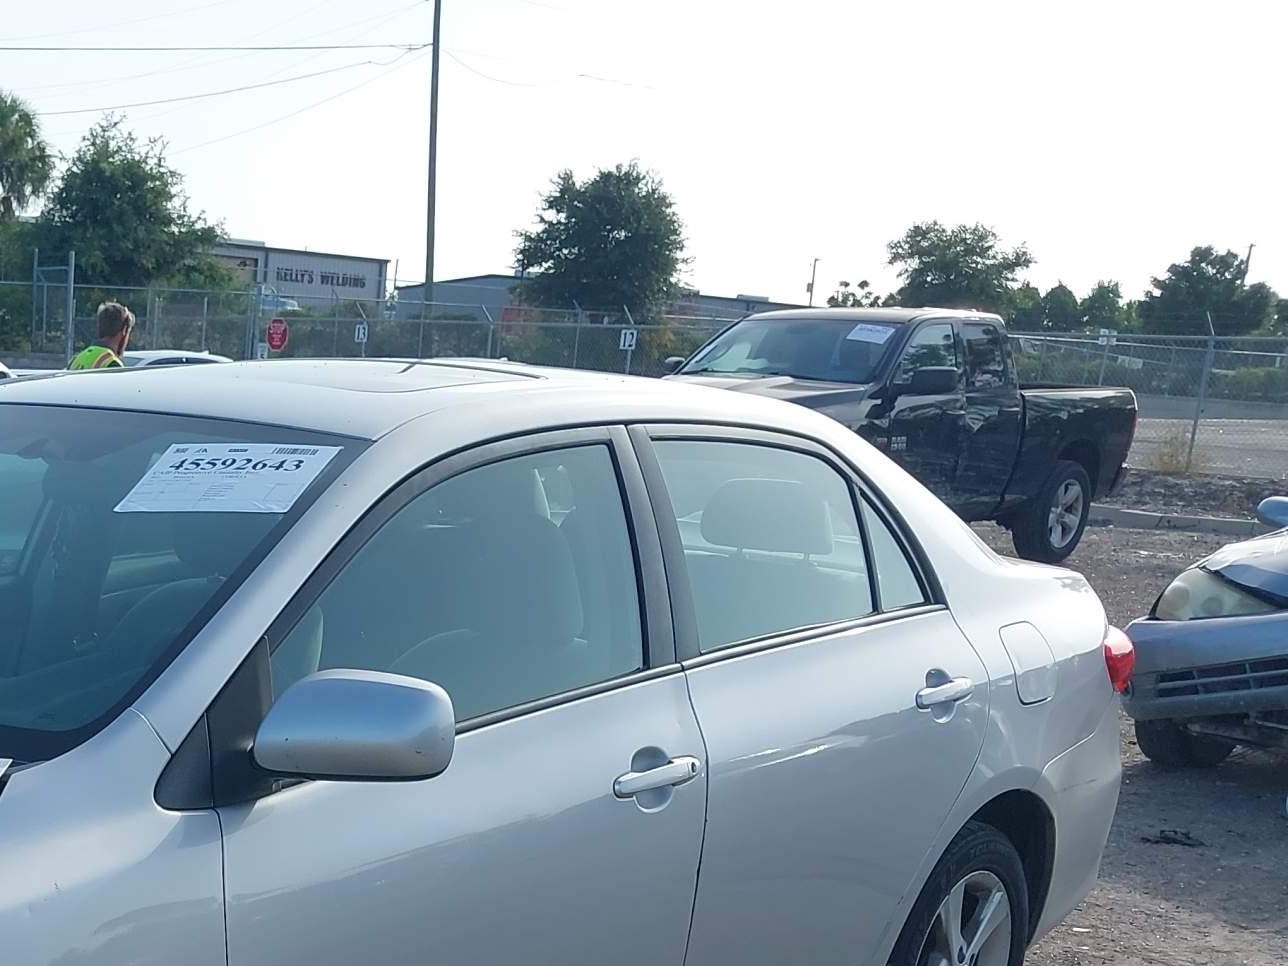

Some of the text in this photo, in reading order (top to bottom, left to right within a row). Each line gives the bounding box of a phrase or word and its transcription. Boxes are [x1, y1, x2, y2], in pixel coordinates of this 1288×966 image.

[276, 266, 366, 288] KELLY'S WELDING
[622, 330, 635, 348] 12
[169, 457, 304, 472] 45592643
